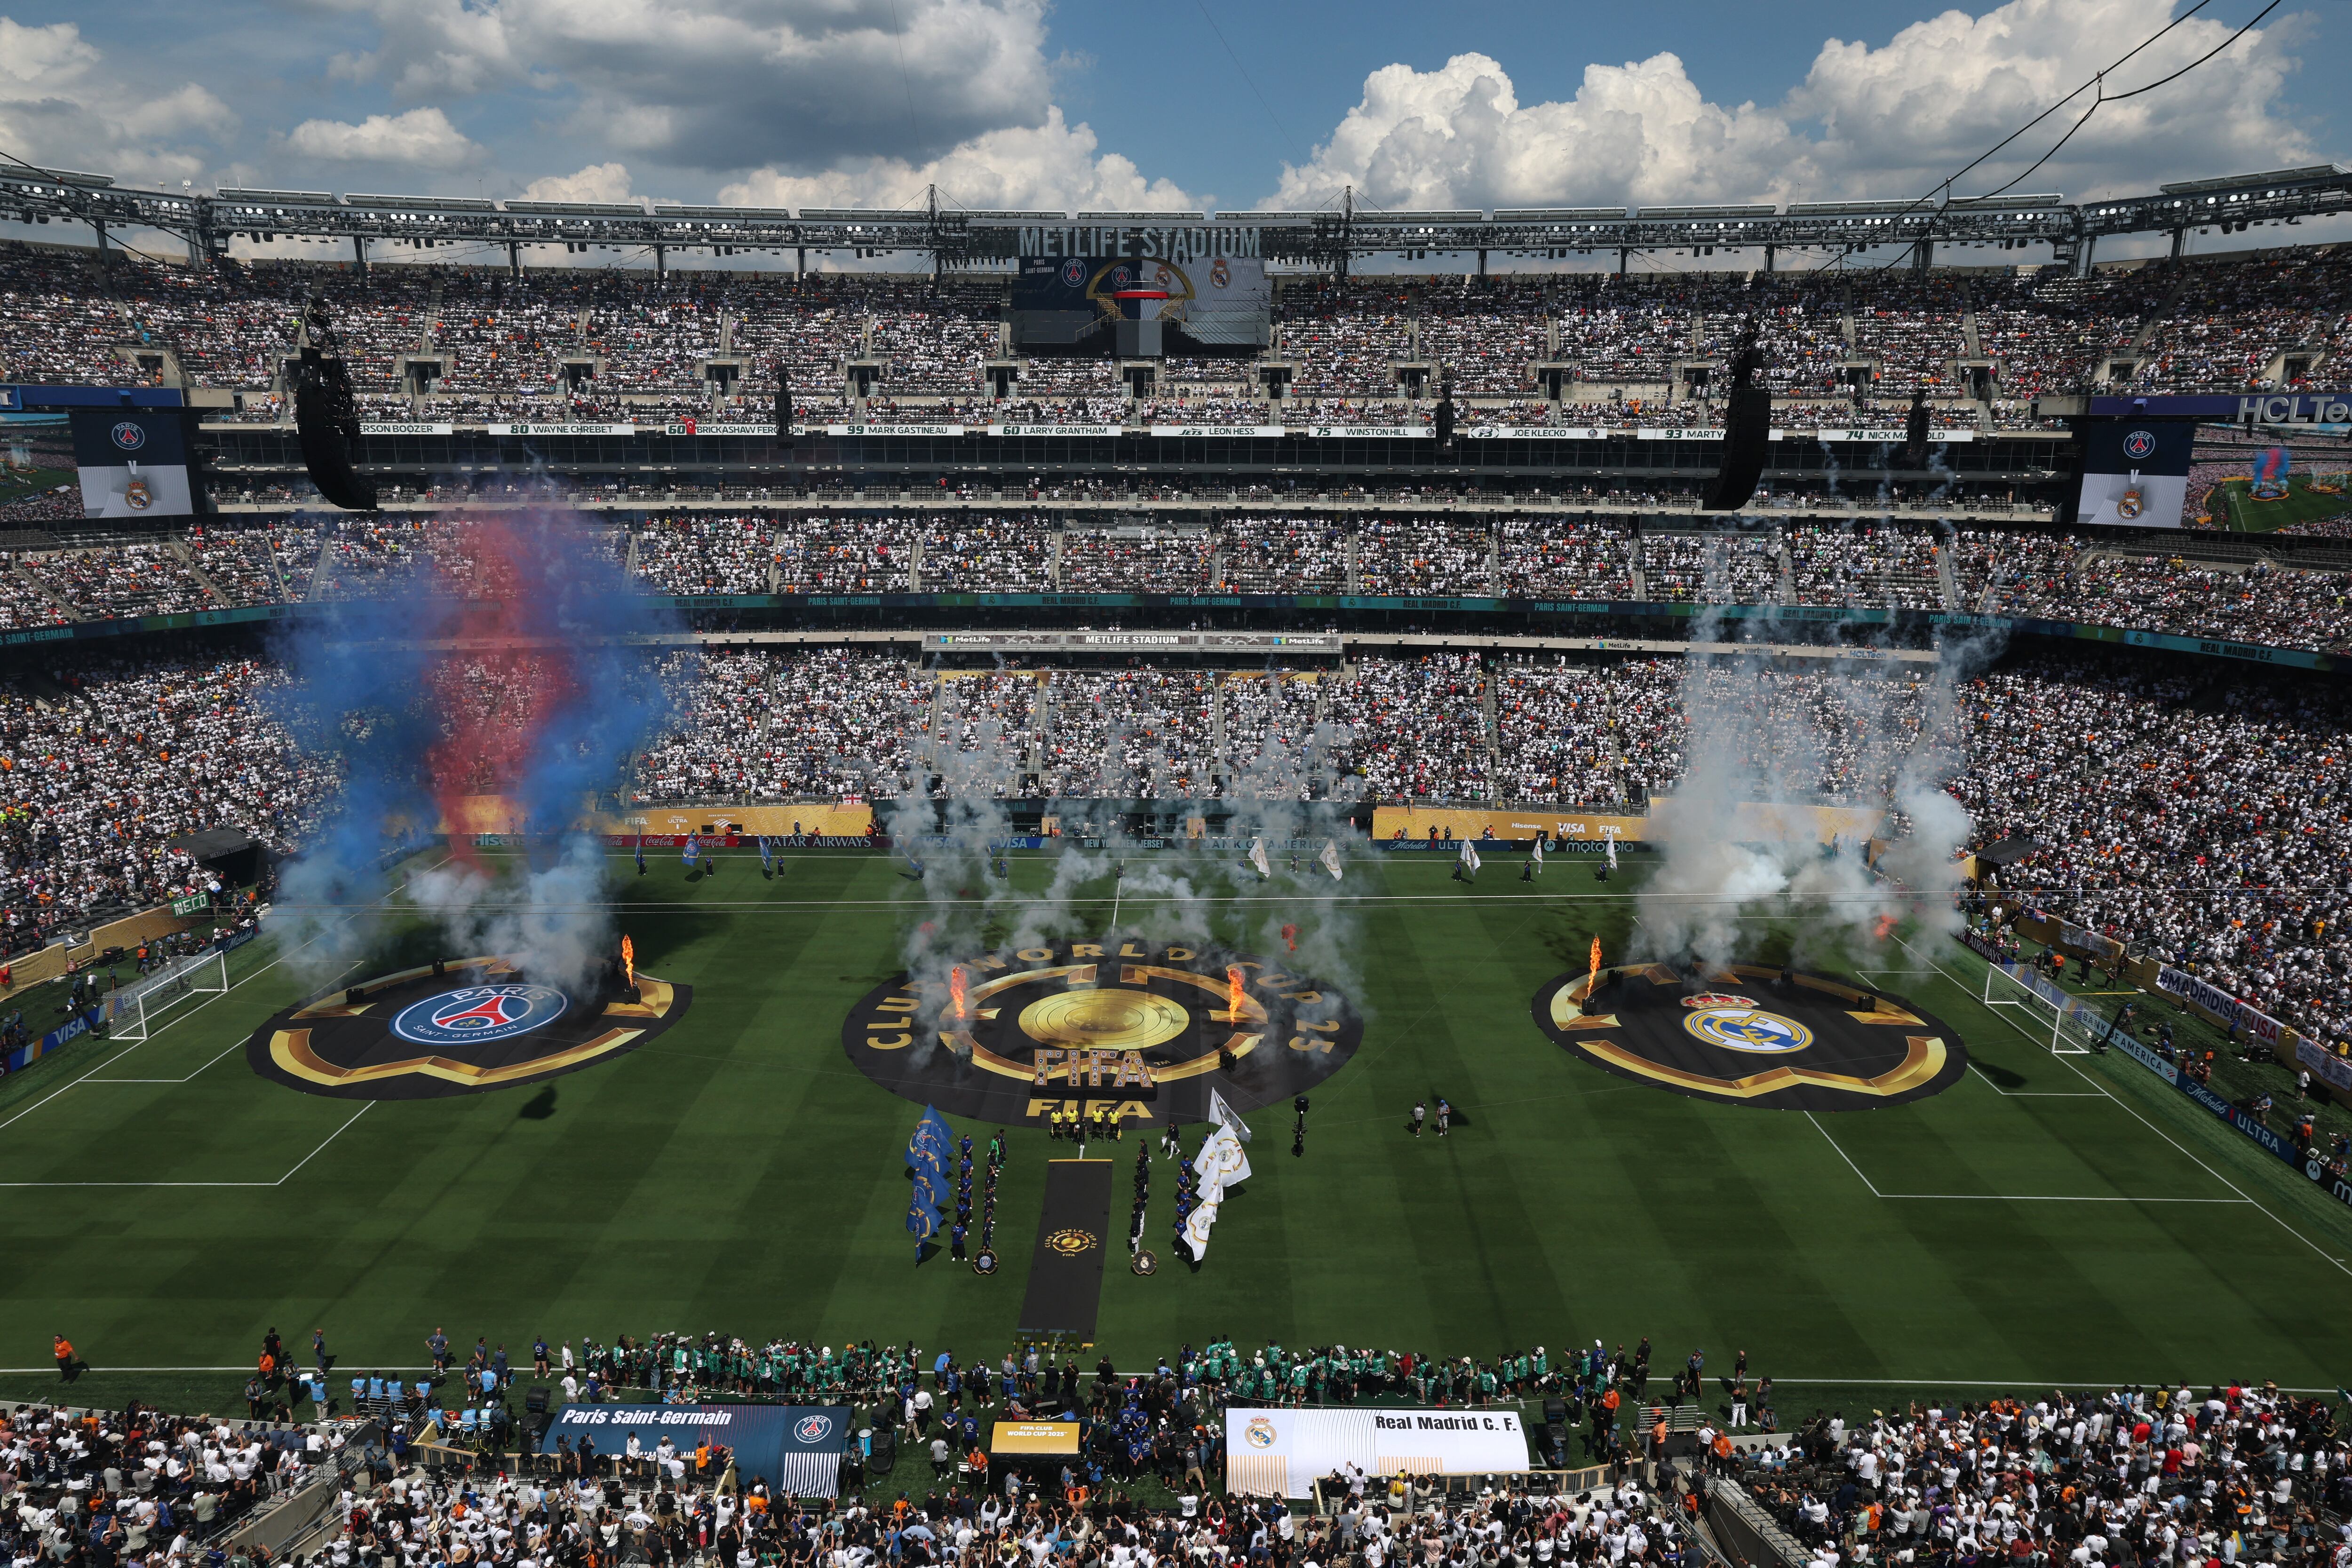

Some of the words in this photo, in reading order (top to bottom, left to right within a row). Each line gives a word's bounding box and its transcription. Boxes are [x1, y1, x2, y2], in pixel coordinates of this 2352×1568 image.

[1019, 227, 1131, 257] METLIFE
[1142, 227, 1260, 257] STADIUM
[2237, 396, 2352, 423] HCLTe
[116, 423, 138, 431] PARIS
[510, 425, 530, 434] 80
[668, 425, 686, 434] 60
[847, 425, 864, 434] 99
[1003, 426, 1020, 435] 60
[1178, 427, 1204, 436] JETS
[1316, 427, 1331, 436] 75
[1665, 429, 1683, 439] 93
[1845, 431, 1864, 440] 74
[1893, 432, 1945, 440] MAOLD
[2130, 431, 2152, 441] PARIS
[127, 460, 137, 475] V
[2130, 469, 2140, 483] V
[675, 599, 691, 607] REAL
[829, 597, 880, 605] SAINT-GERMAIN
[1042, 596, 1058, 605] REAL
[1060, 596, 1086, 605] MADRID
[1088, 596, 1099, 605] C.F.
[1191, 597, 1241, 606] SAINT-GERMAIN
[1403, 600, 1420, 608] REAL
[1422, 600, 1448, 609] MADRID
[1450, 601, 1461, 609] C.F.
[1534, 602, 1554, 611] PARIS
[1557, 603, 1609, 613] SAINT-GERMAIN
[1783, 609, 1800, 618] REAL
[1803, 610, 1832, 619] MADRID
[1929, 614, 1951, 624] PARIS
[6, 628, 74, 645] SAINT-GERMAIN
[1085, 635, 1129, 644] METLIFE
[1132, 635, 1179, 644] STADIUM
[1850, 650, 1887, 659] HCLTech
[2201, 642, 2220, 654] REAL
[2223, 645, 2256, 658] MADRID
[2258, 649, 2273, 661] C.F.
[1556, 823, 1586, 833] VISA
[471, 835, 541, 846] Hisense
[645, 836, 675, 847] Coca-Cola
[698, 836, 727, 847] Coca-Cola
[813, 836, 871, 847] AIRWAYS
[998, 837, 1027, 848] VISA
[1084, 839, 1099, 847] NEW
[1121, 839, 1136, 848] NEW
[1139, 839, 1164, 848] JERSEY
[1203, 840, 1243, 849] BANK
[1389, 841, 1429, 850] Michelob
[1438, 841, 1475, 850] ULTA
[210, 849, 229, 859] METLIFE
[230, 843, 249, 854] STADIUM
[1976, 851, 1993, 862] METLIFE
[224, 927, 254, 951] Michelob
[1968, 935, 2002, 965] AIRWAYS
[451, 986, 552, 1002] PARIS
[866, 980, 946, 1050] CLUB
[956, 943, 1197, 973] WORLD
[1225, 962, 1323, 1004] CUP
[1289, 1019, 1340, 1053] 25
[52, 1017, 86, 1044] VISA
[2250, 1015, 2277, 1043] USA
[2121, 1037, 2162, 1072] AMERICA
[1034, 1048, 1154, 1088] FIFA
[1025, 1099, 1154, 1118] FIFA
[2186, 1081, 2226, 1115] Michelob
[2237, 1113, 2280, 1153] ULTRA
[1044, 1235, 1053, 1248] CLUB
[1085, 1232, 1097, 1241] CUP
[562, 1409, 608, 1425] Paris
[611, 1410, 732, 1425] Saint-Germain
[1376, 1416, 1412, 1429] Real
[1417, 1416, 1478, 1431] Madrid
[1483, 1418, 1499, 1431] C.
[1503, 1418, 1517, 1431] F.
[633, 1520, 643, 1529] 10
